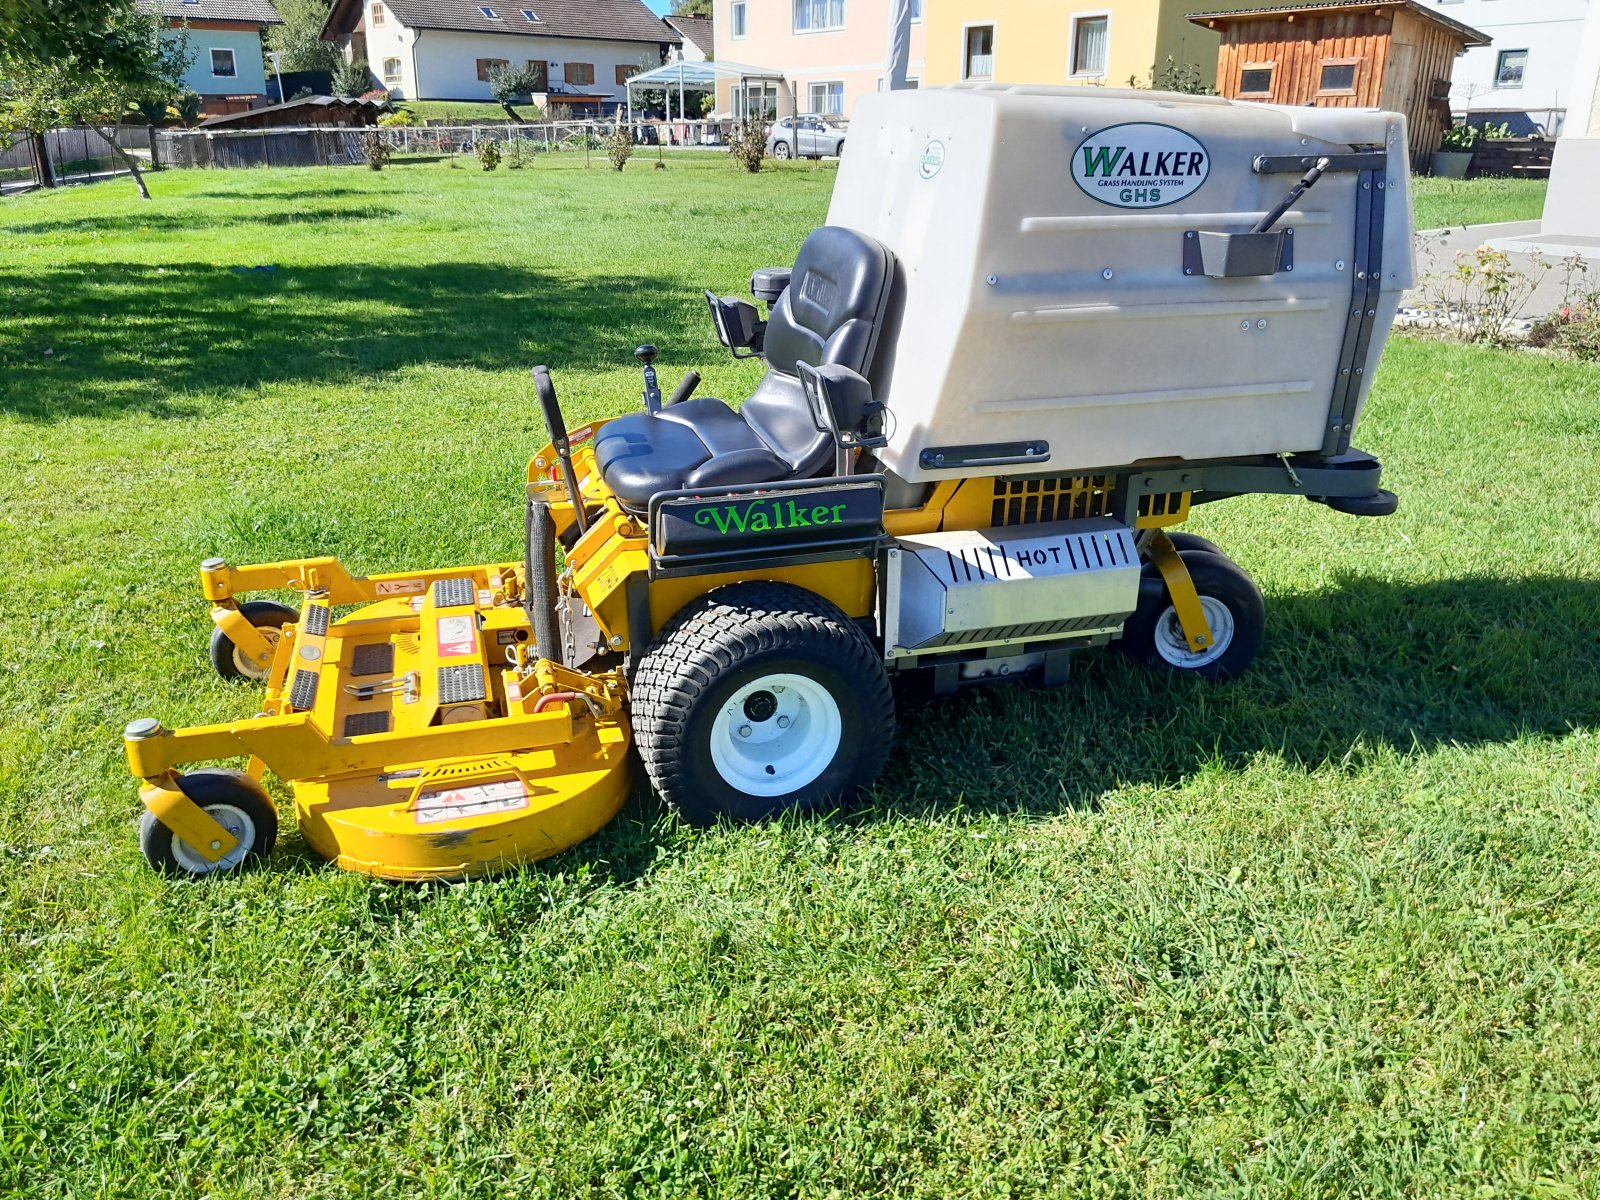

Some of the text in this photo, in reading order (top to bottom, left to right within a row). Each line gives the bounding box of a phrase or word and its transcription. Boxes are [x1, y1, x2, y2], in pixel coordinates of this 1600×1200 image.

[1083, 147, 1203, 177] WALKER
[1098, 178, 1184, 187] GRASS HANDLING SYSTEM
[1119, 188, 1161, 202] GHS
[694, 500, 847, 534] Walker
[1016, 546, 1060, 567] HOT
